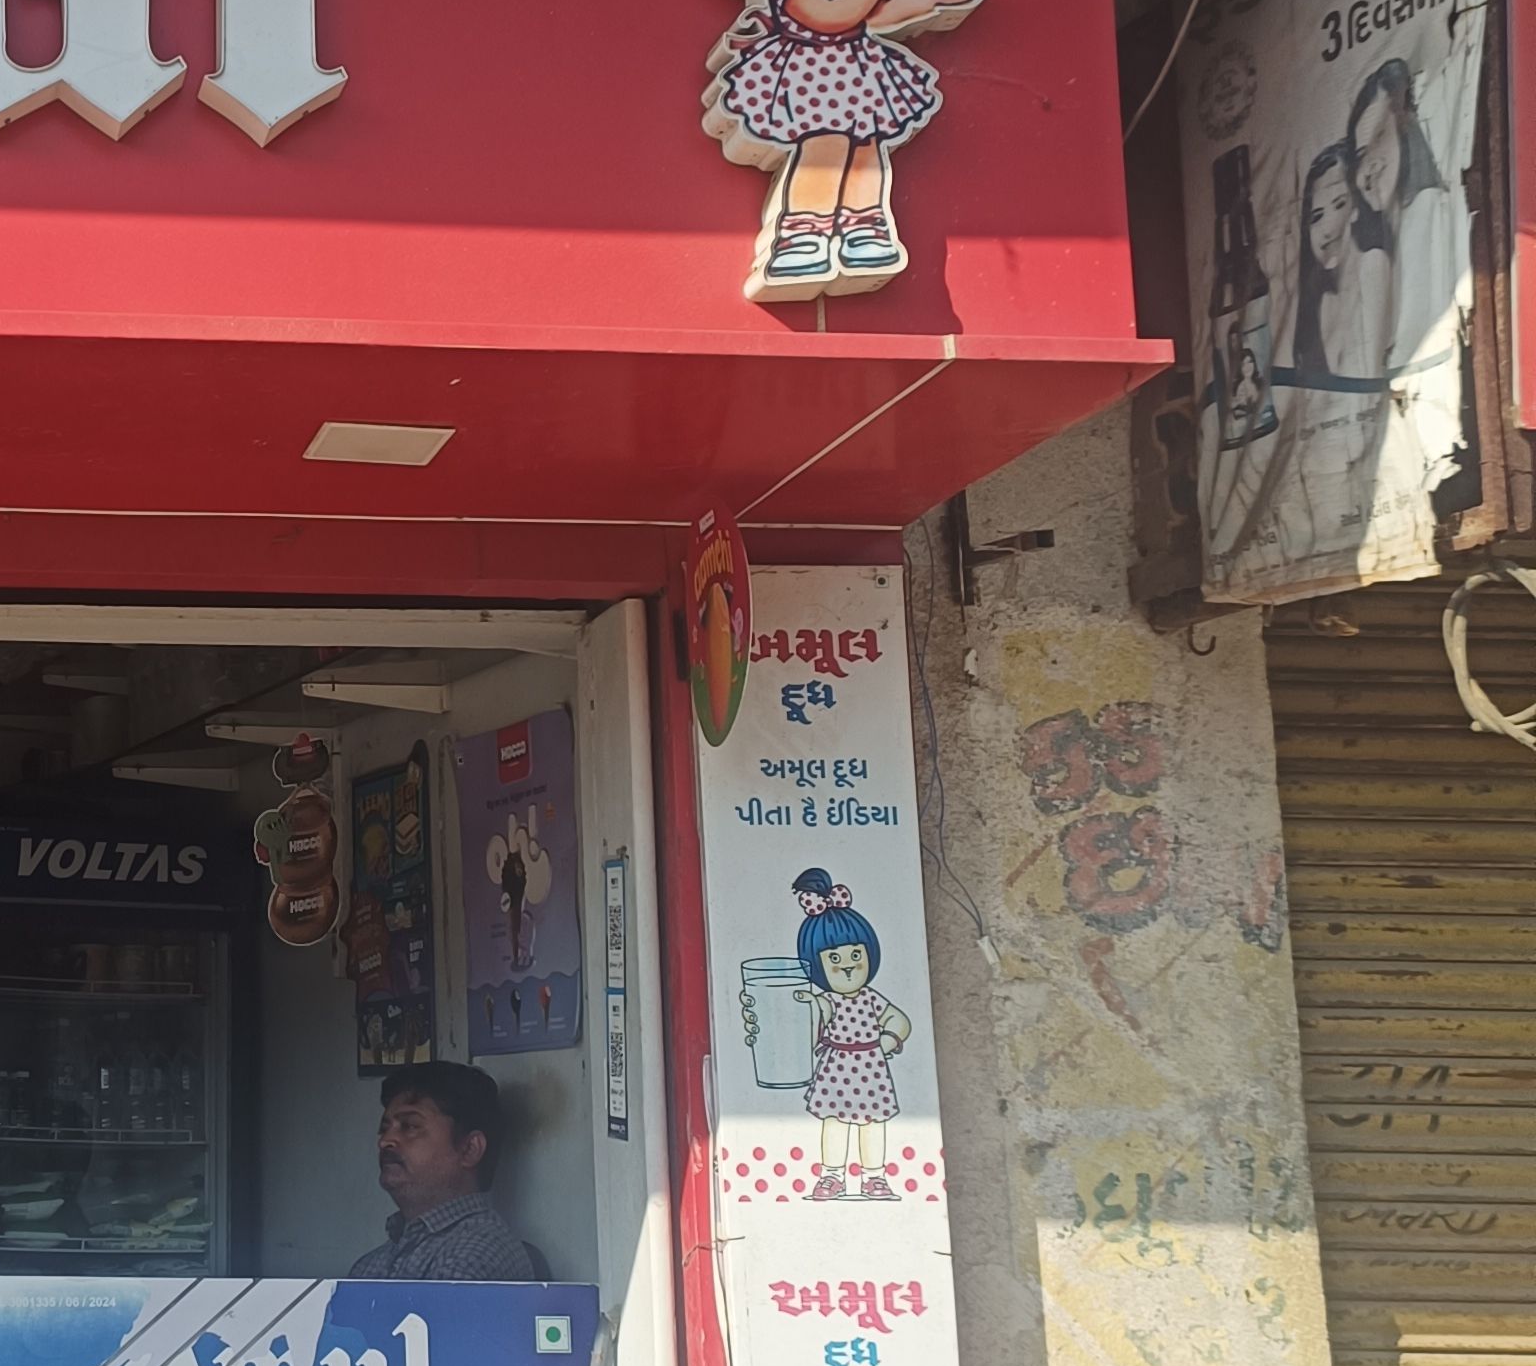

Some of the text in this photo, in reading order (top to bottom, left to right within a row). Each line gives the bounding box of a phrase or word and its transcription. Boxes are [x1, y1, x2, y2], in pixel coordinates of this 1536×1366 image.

[781, 679, 837, 725] દૂધ
[759, 757, 868, 788] અમૂલ દૂધ
[734, 797, 791, 826] પીતા
[801, 796, 818, 827] હૈ
[16, 836, 208, 885] VOLTAS
[88, 1296, 117, 1308] 2024
[768, 1280, 928, 1334] અમૂલ
